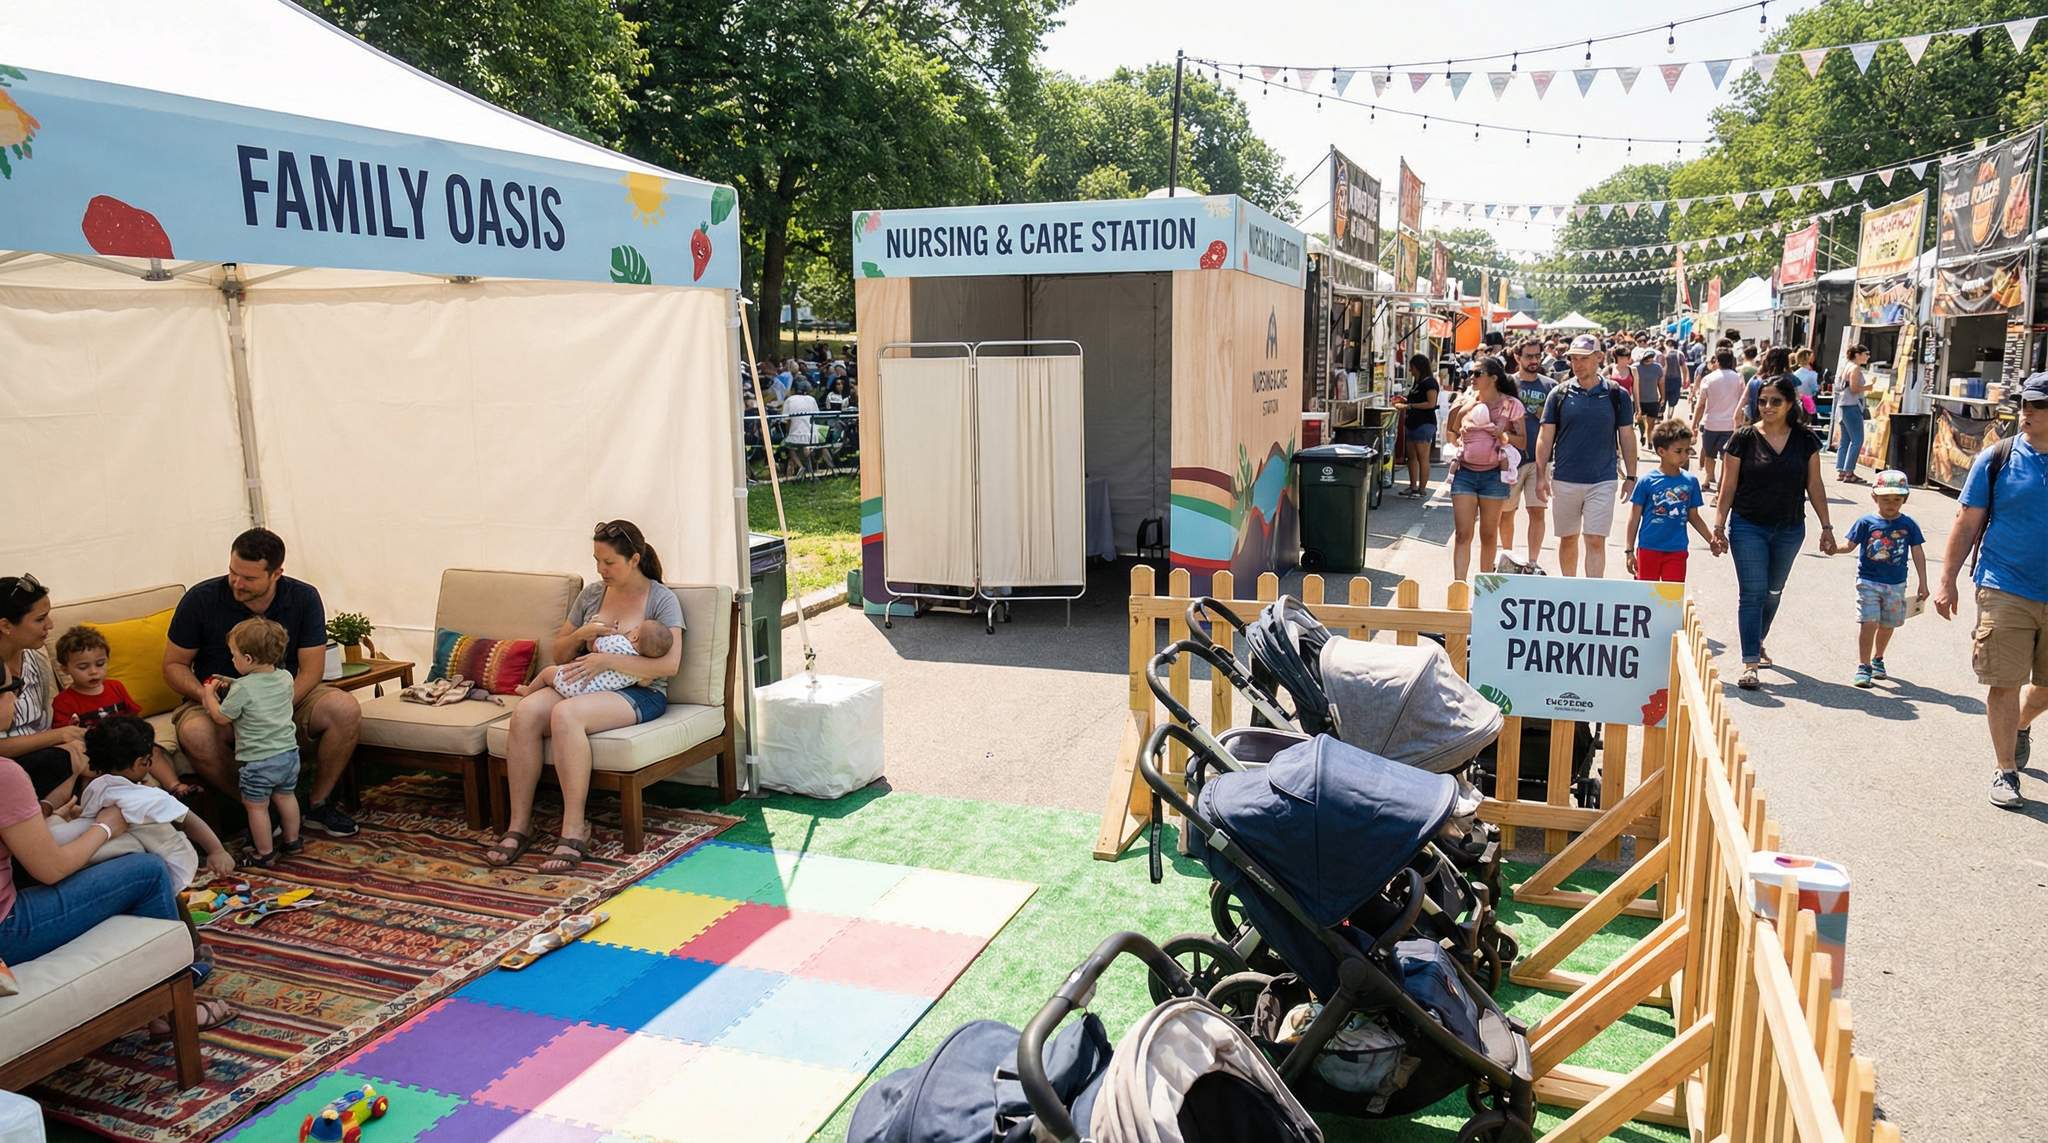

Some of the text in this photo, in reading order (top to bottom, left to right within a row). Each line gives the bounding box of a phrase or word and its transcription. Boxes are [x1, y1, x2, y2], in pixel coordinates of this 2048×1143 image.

[236, 144, 566, 252] FAMILY OASIS
[886, 217, 1196, 259] NURSING & CARE STATION
[1499, 597, 1653, 639] STROLLER
[1506, 638, 1640, 680] PARKING
